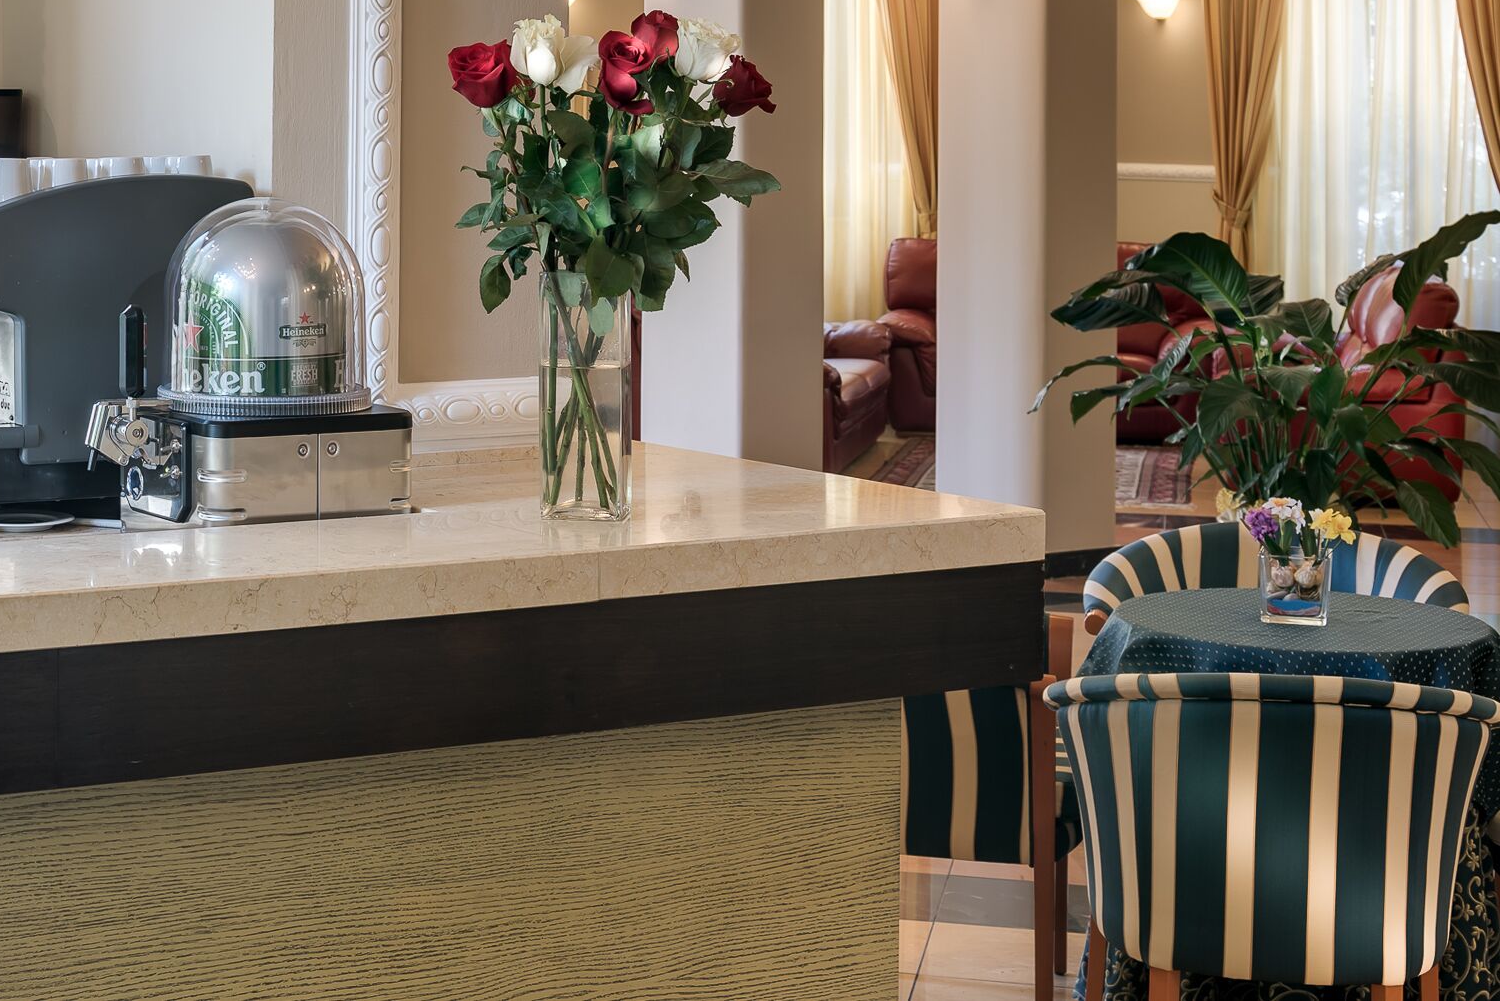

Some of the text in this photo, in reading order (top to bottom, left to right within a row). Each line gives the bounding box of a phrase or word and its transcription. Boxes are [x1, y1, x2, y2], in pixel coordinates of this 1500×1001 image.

[193, 290, 239, 349] ORIGINAL
[282, 327, 325, 337] Heineken
[182, 363, 264, 395] neken
[291, 369, 318, 380] FRESH
